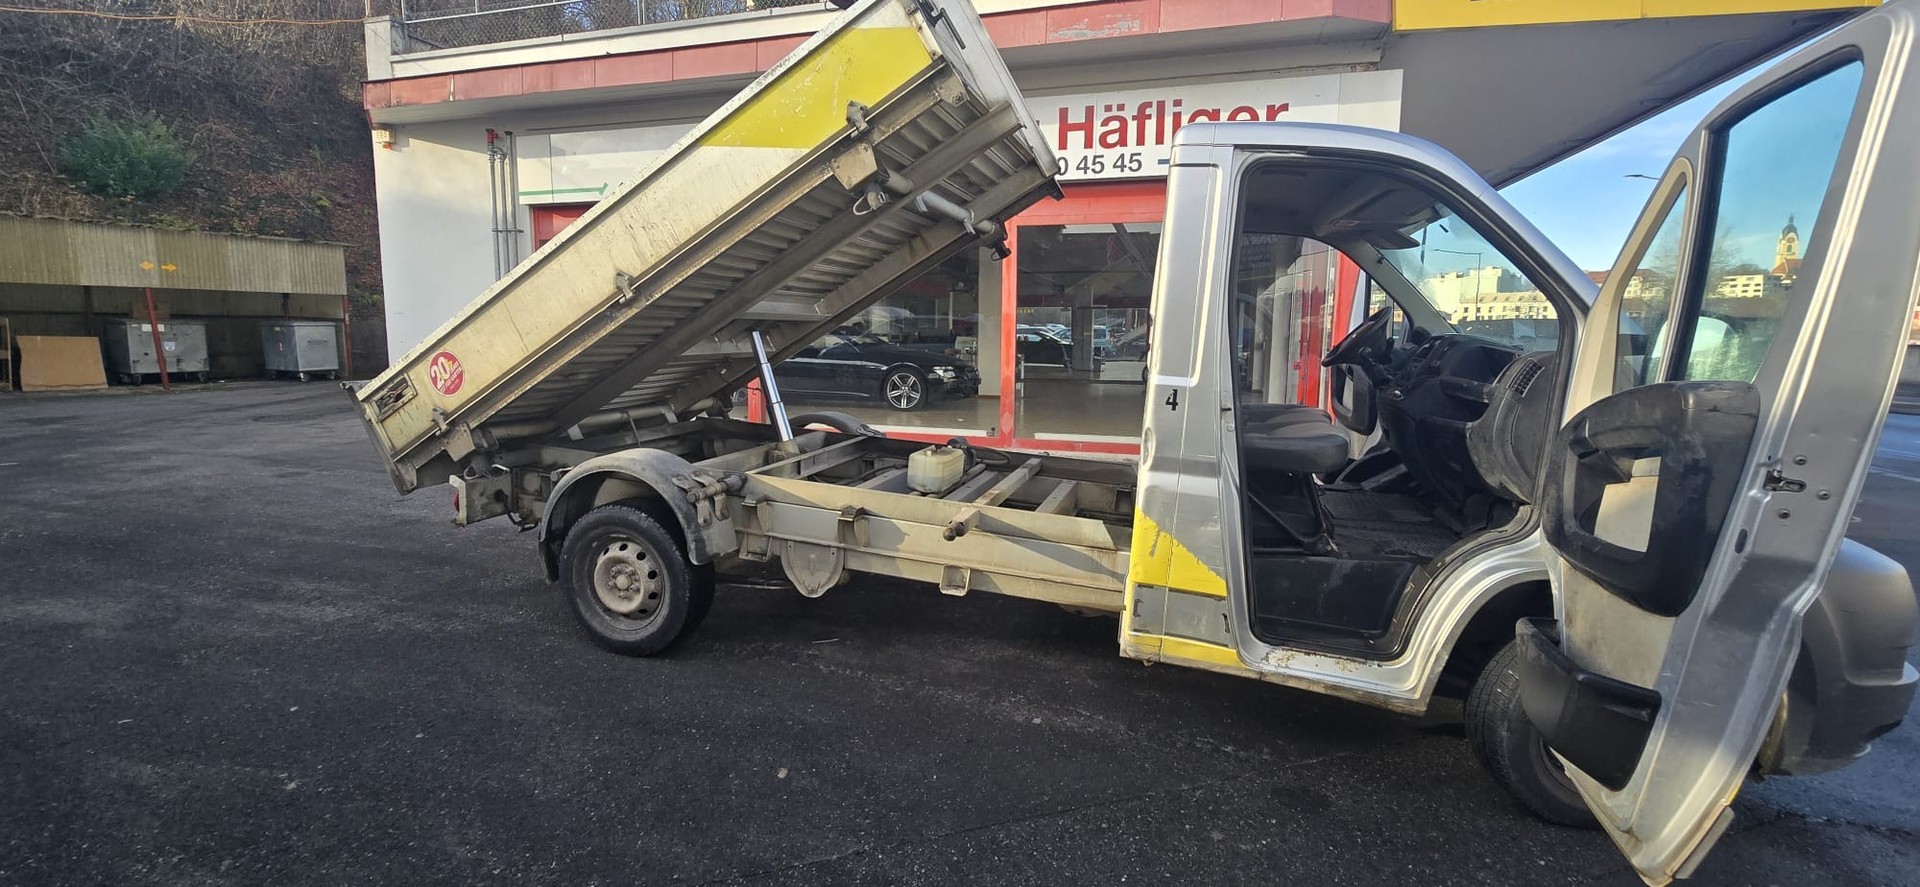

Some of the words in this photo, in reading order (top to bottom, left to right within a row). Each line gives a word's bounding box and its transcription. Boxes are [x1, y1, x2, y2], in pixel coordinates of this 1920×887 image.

[1076, 154, 1105, 174] 45
[1112, 152, 1143, 173] 45
[431, 356, 450, 389] 20
[1165, 388, 1179, 411] 4
